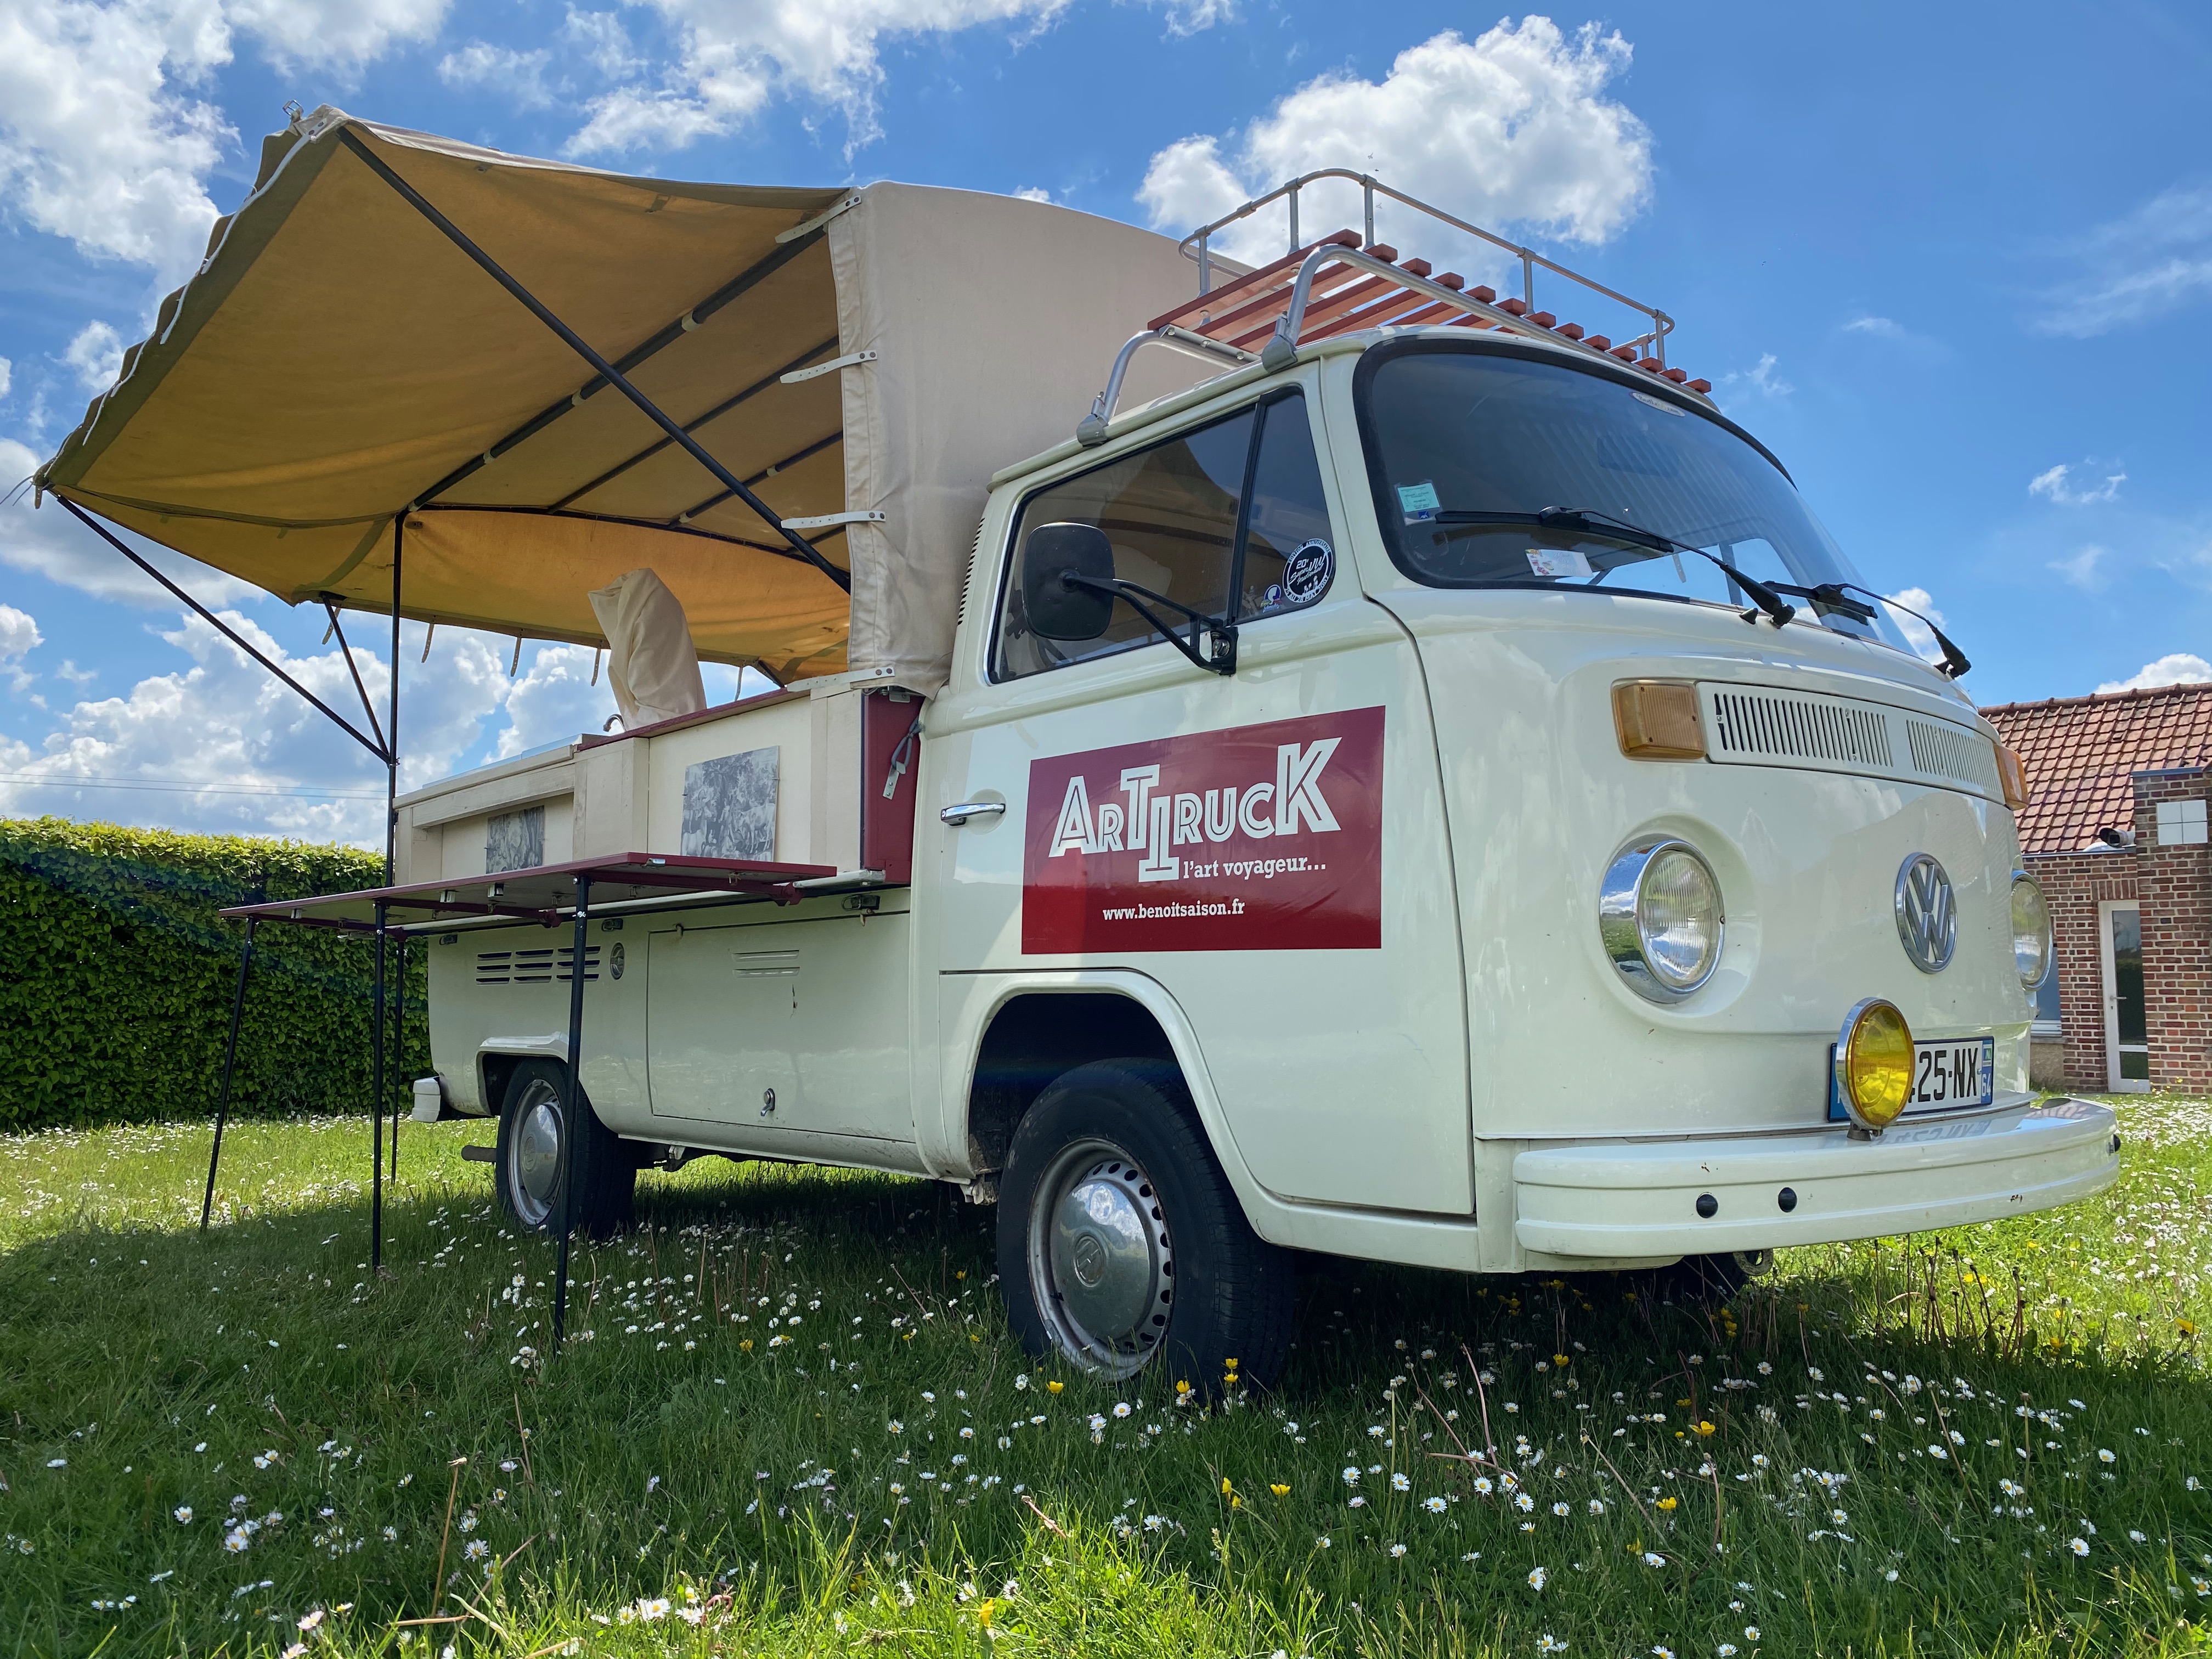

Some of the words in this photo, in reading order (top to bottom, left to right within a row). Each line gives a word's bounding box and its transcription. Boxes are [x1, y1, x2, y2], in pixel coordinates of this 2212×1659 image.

[1183, 859, 1219, 879] l'art
[1223, 856, 1327, 881] voyageur...
[1102, 898, 1245, 921] www.benoitsaison.fr
[1908, 1047, 1978, 1103] 25-NX
[1982, 1073, 1991, 1097] 64
